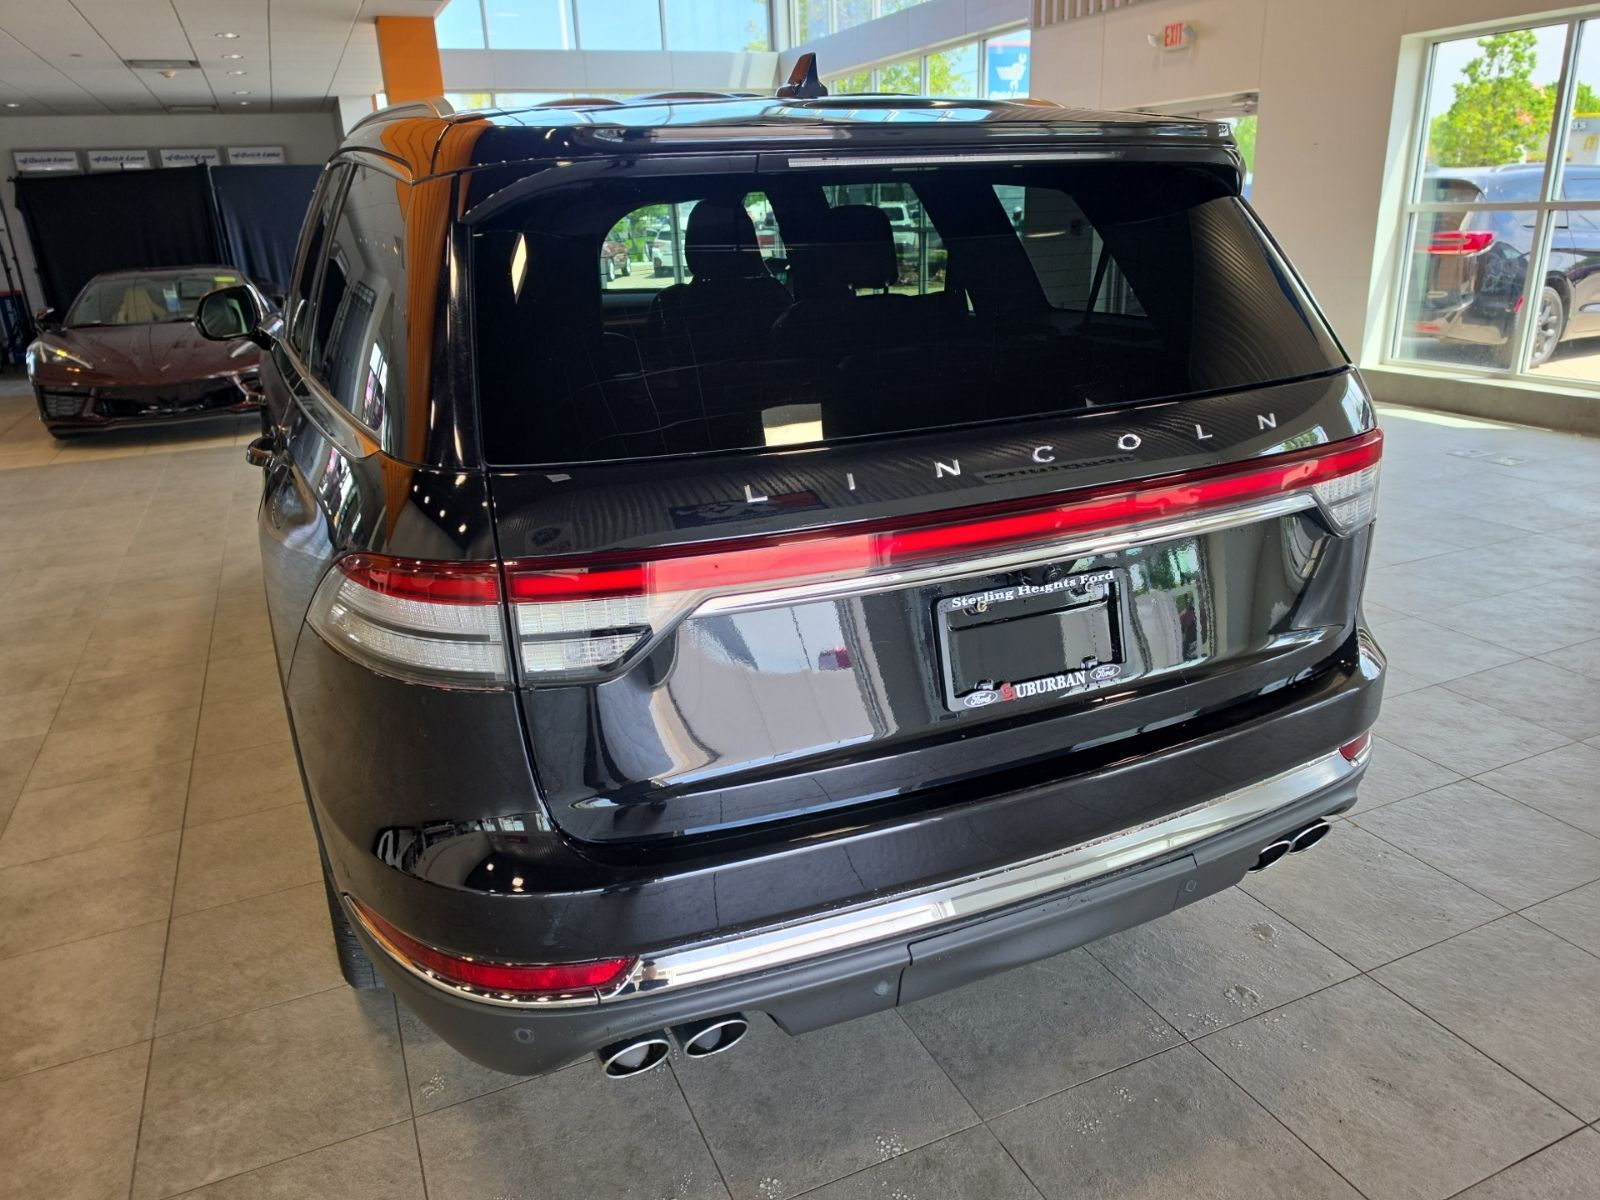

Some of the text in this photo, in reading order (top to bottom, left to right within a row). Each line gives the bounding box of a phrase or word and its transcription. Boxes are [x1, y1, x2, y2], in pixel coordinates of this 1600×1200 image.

[1164, 22, 1184, 48] EXIT
[102, 154, 146, 163] Quick Lane
[743, 412, 1277, 504] LINCOLN
[951, 570, 1114, 608] Sterling Heights Ford
[1000, 670, 1086, 703] SUBURBAN
